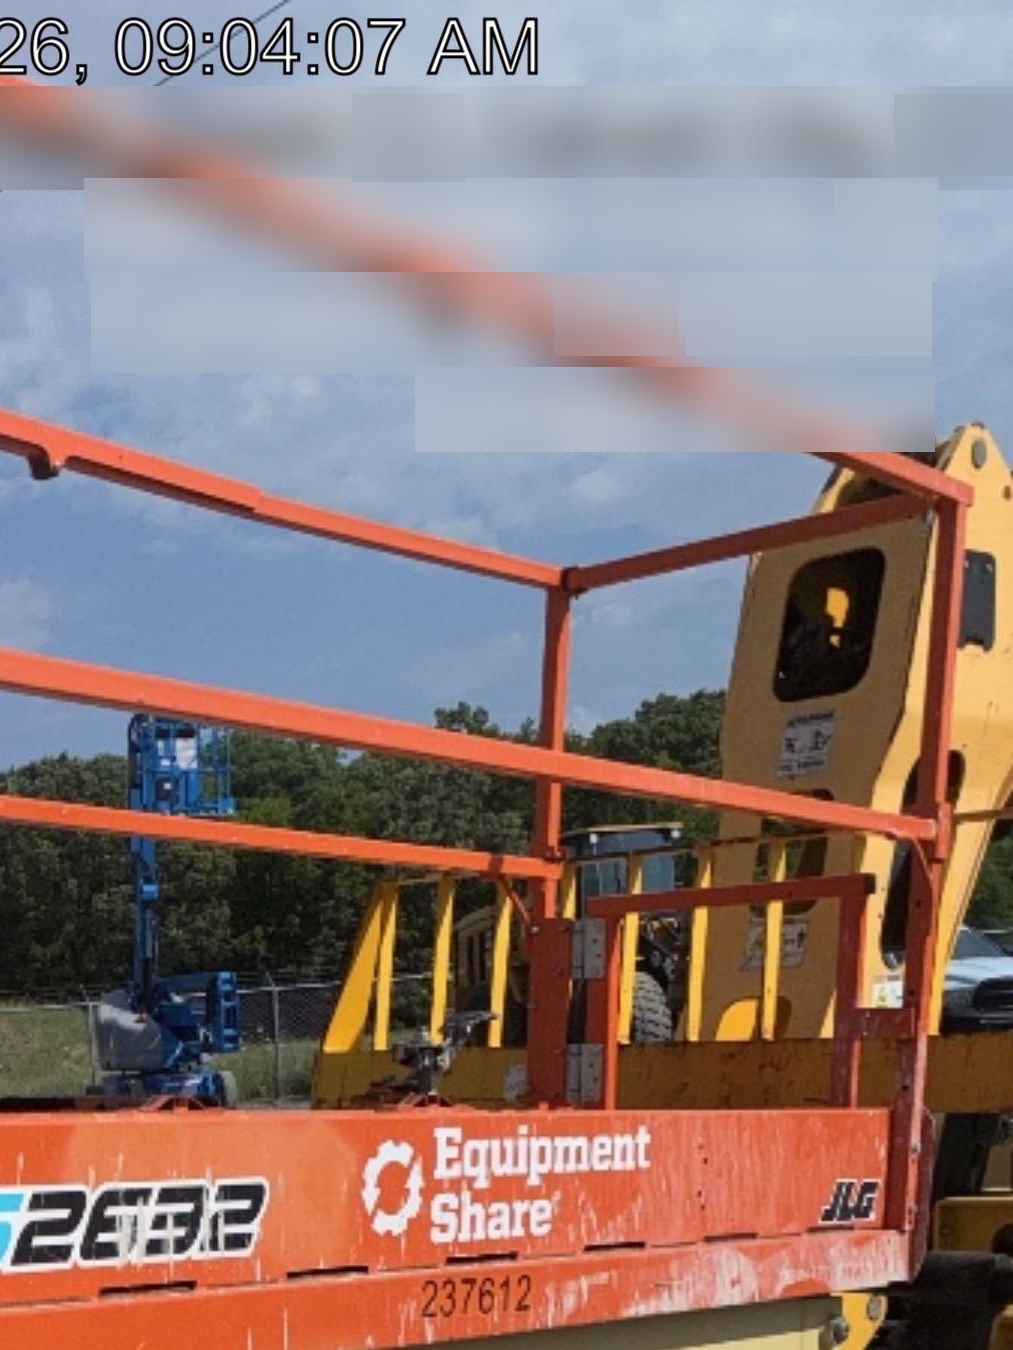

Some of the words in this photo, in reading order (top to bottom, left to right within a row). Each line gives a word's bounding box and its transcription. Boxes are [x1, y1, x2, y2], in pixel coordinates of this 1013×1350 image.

[433, 1125, 652, 1189] Equipment
[430, 1190, 553, 1244] Share
[818, 1178, 882, 1225] JLG
[421, 1274, 532, 1318] 237612
